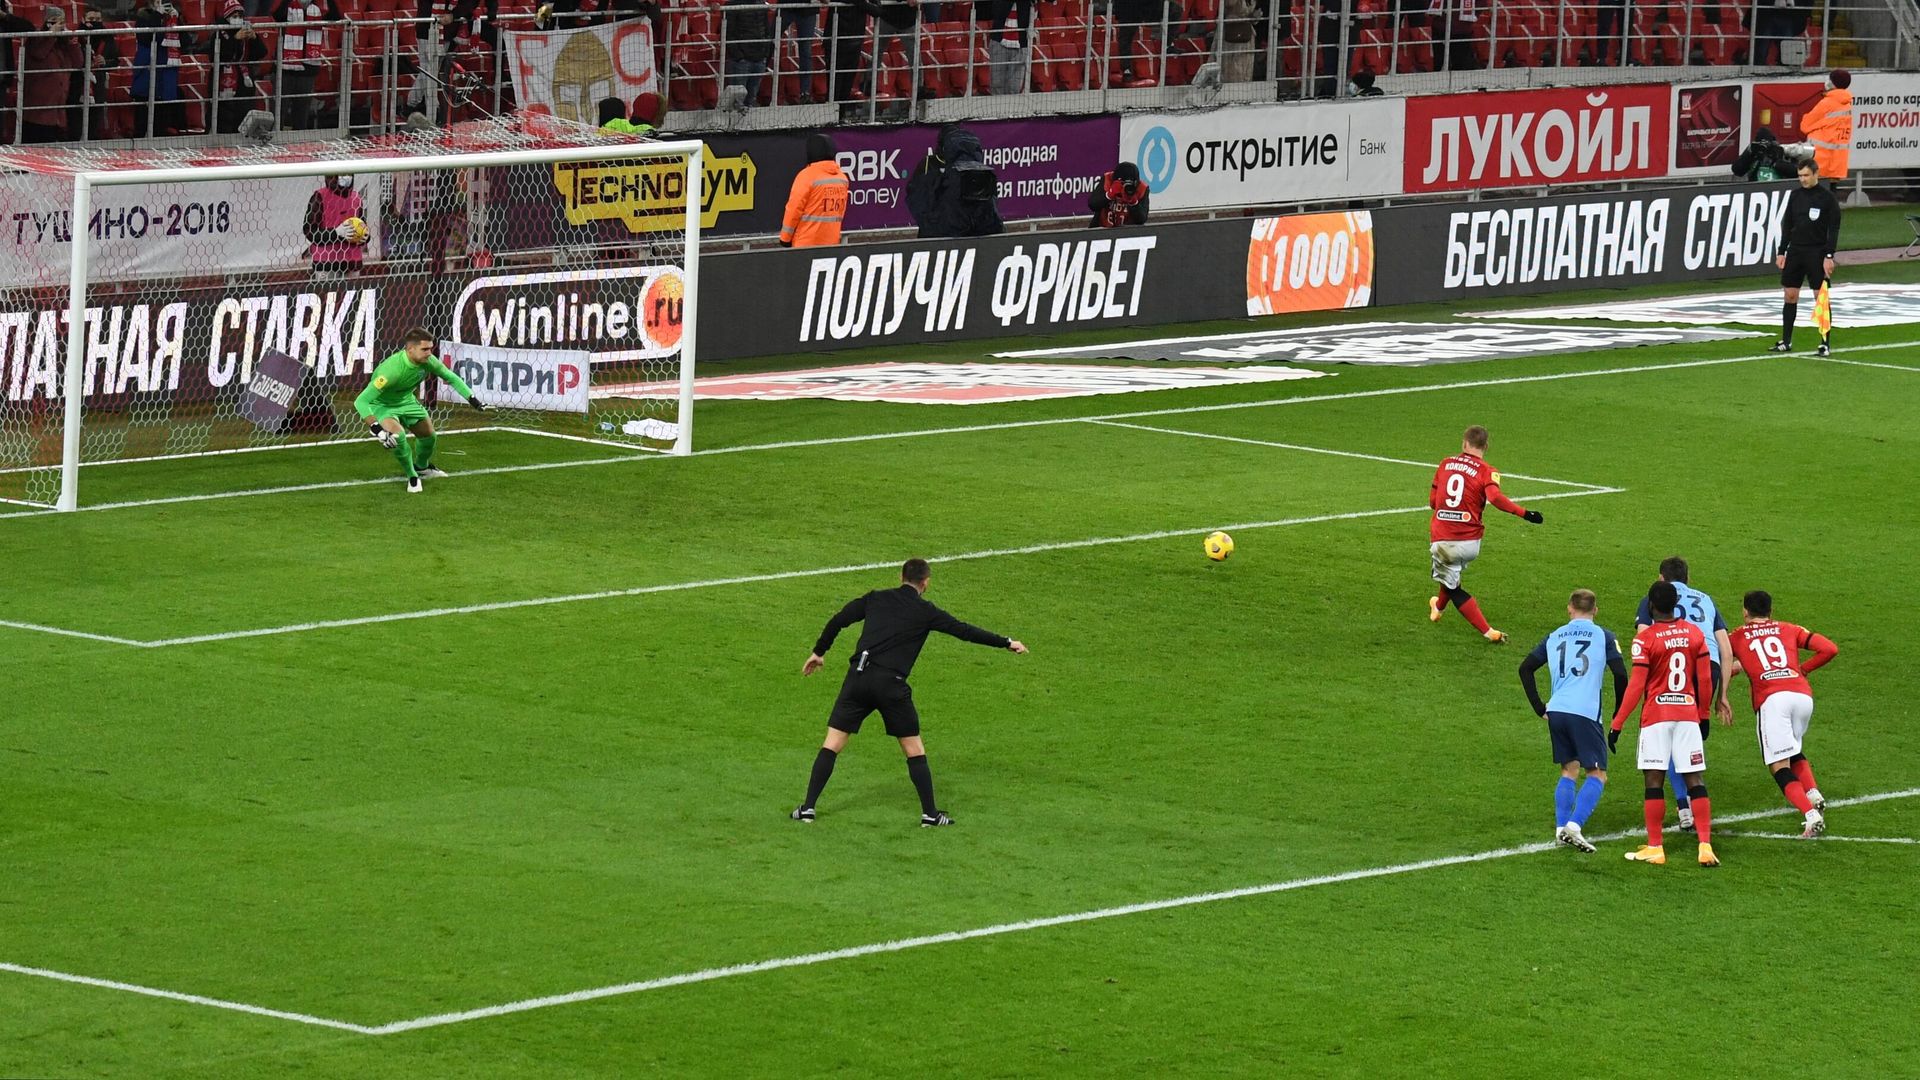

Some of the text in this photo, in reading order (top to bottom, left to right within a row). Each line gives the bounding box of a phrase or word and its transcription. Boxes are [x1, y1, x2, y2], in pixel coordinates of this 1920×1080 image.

[1887, 95, 1901, 105] по
[1858, 109, 1920, 129] ЛУКОЙЛ
[1423, 92, 1650, 184] ЛУКОЙЛ
[1856, 136, 1919, 149] auto.lukoil.ru
[1186, 133, 1387, 182] открытие Банк
[1272, 230, 1350, 292] 1000
[1444, 198, 1670, 289] БЕСПЛАТНАЯ
[799, 236, 1157, 342] ПОЛУЧИ ФРИБЕТ
[475, 292, 630, 347] Winline
[208, 289, 376, 388] СТАВКА
[1445, 462, 1478, 478] КОКОРИН
[1445, 473, 1465, 508] 9
[1558, 630, 1593, 639] МАКАРОВ
[1655, 628, 1690, 638] NISSAN
[1664, 637, 1689, 649] МОЗЕС
[1556, 640, 1591, 678] 13
[1668, 651, 1686, 692] 8
[1749, 636, 1788, 671] 19
